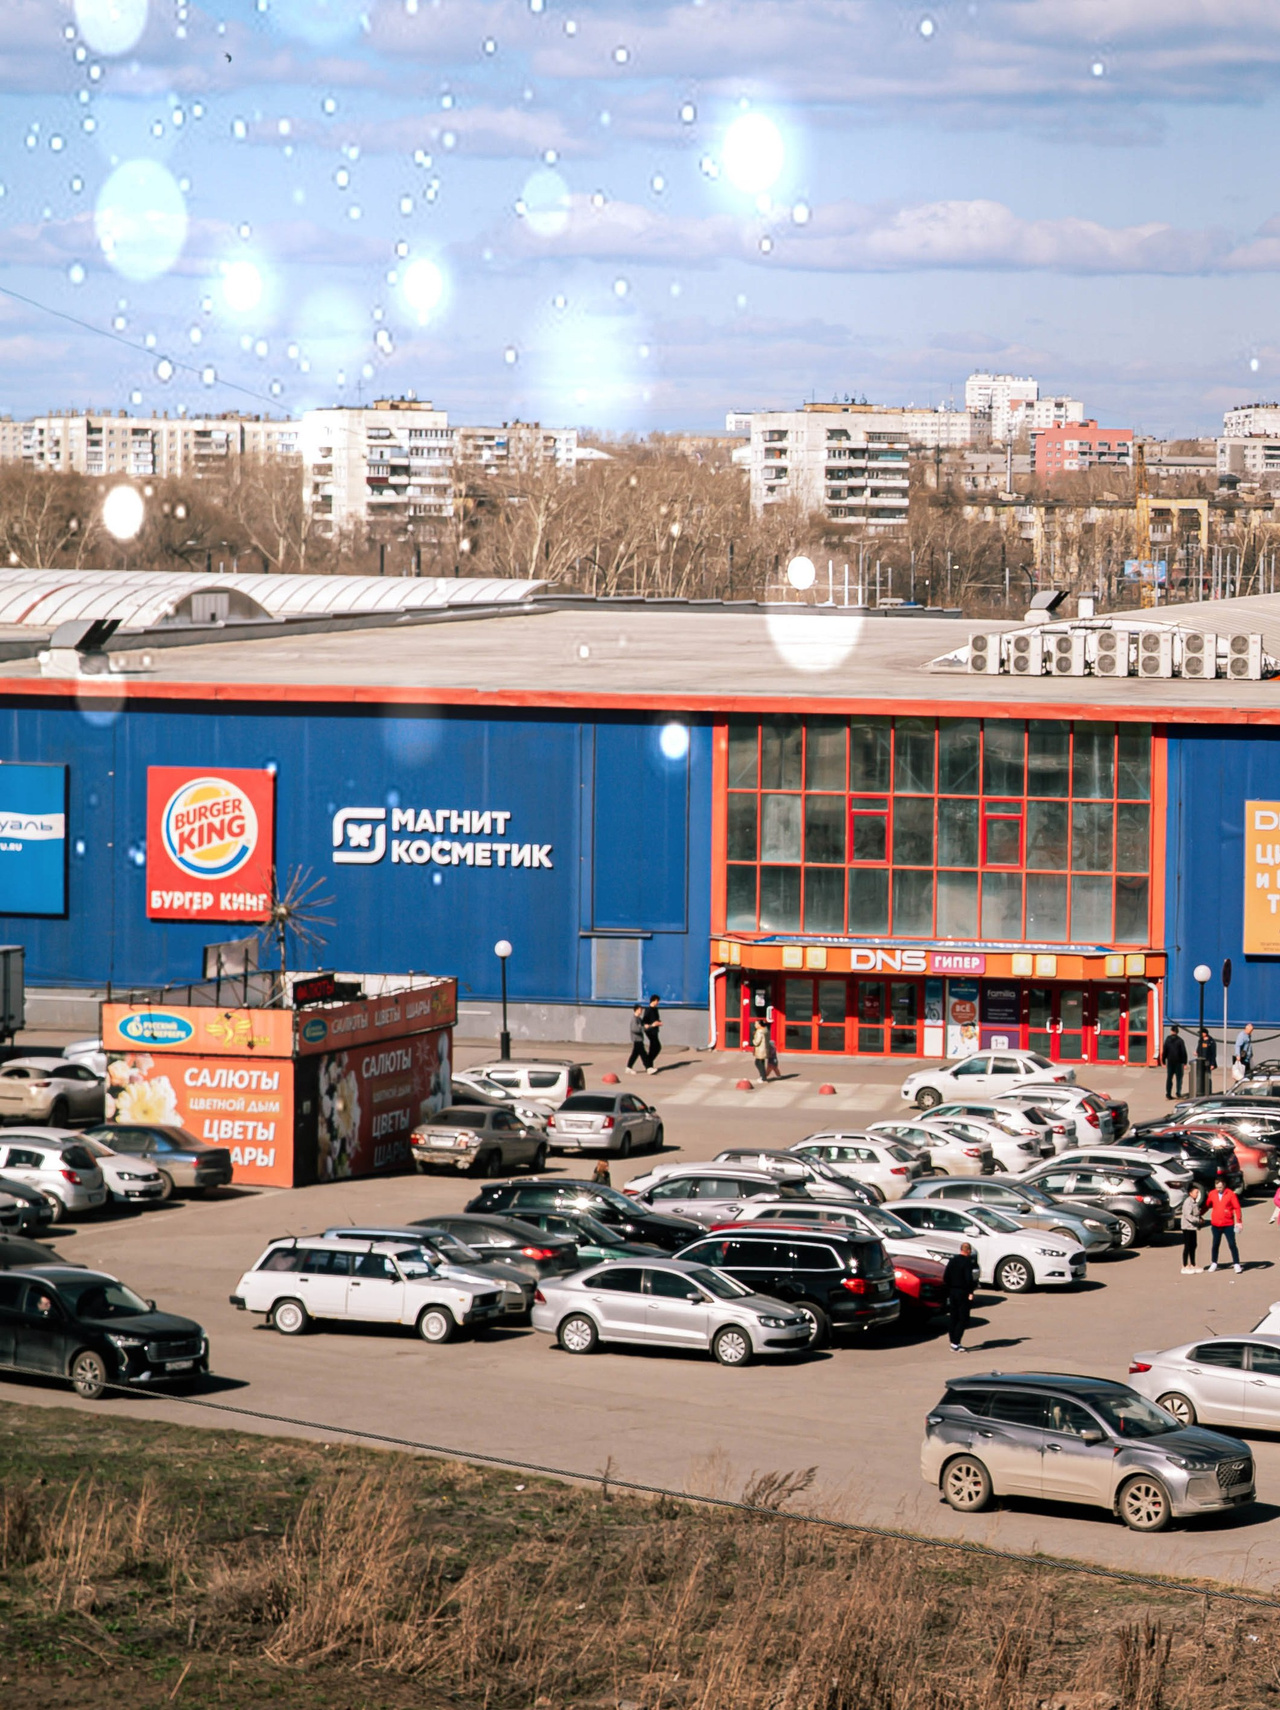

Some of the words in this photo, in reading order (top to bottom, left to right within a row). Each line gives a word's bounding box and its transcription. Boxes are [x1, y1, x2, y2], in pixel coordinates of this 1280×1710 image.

[175, 799, 242, 831] BURGER
[391, 808, 511, 834] МАГНИТ
[178, 815, 245, 855] KING
[391, 839, 553, 868] КОСМЕТИК
[1256, 872, 1269, 889] и
[150, 890, 214, 911] БУРГЕР
[220, 892, 268, 911] КИНГ
[852, 949, 927, 972] DNS
[934, 956, 980, 969] ГИПЕР
[987, 989, 1016, 998] familia
[331, 1013, 368, 1034] САЛЮТЫ
[375, 1006, 401, 1027] ЦВЕТЫ
[405, 999, 431, 1019] ШАРЫ
[362, 1048, 412, 1078] САЛЮТЫ
[184, 1067, 279, 1090] САЛЮТЫ
[189, 1097, 245, 1113] ЦВЕТНОЙ
[247, 1100, 280, 1113] ДЫМ
[203, 1118, 275, 1142] ЦВЕТЫ
[372, 1108, 410, 1139] ЦВЕТЫ
[228, 1145, 275, 1168] АРЫ
